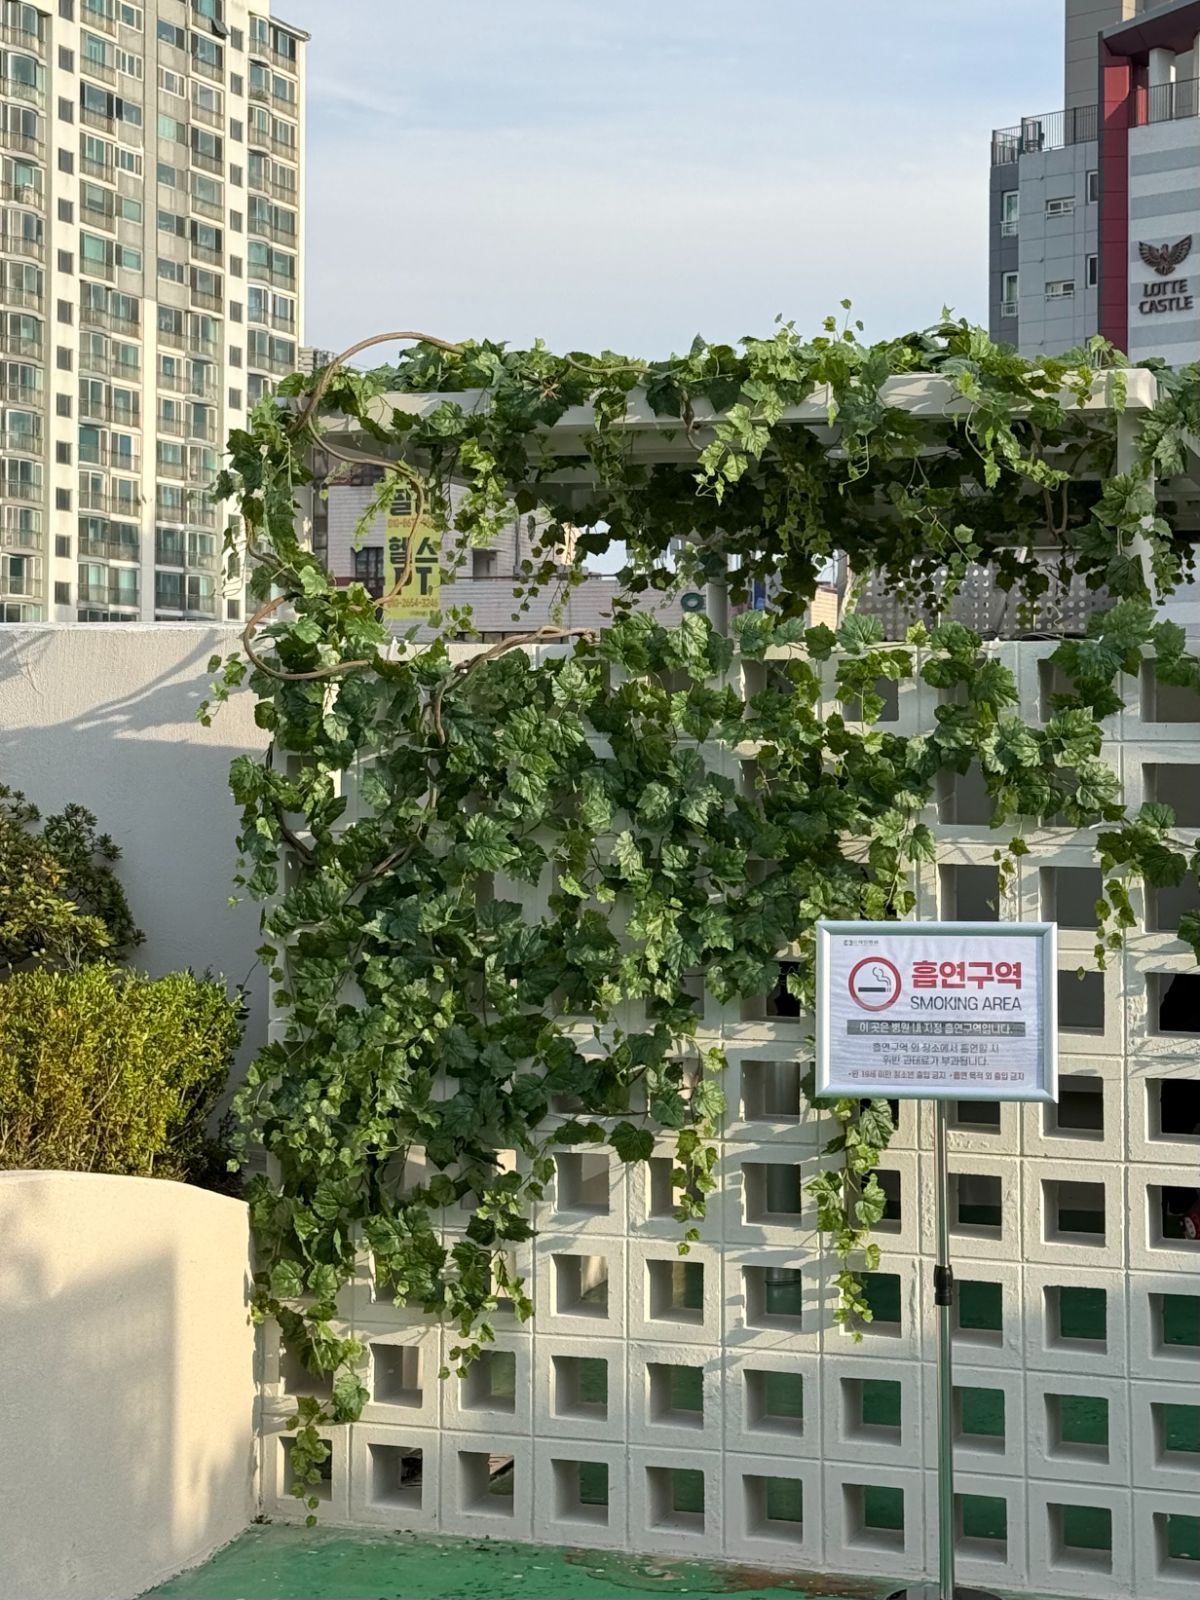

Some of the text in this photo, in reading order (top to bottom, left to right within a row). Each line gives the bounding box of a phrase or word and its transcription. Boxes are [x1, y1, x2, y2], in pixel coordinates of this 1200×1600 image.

[1143, 279, 1188, 297] LOTTE
[1138, 295, 1194, 315] CASTLE
[911, 960, 1022, 990] 흡연구역
[910, 995, 1022, 1011] SMOKING AREA
[859, 1021, 869, 1033] 이
[871, 1022, 890, 1033] 곳은
[891, 1022, 910, 1034] 병원
[923, 1022, 943, 1034] 지정
[944, 1022, 1013, 1035] 흡연구역입니다.
